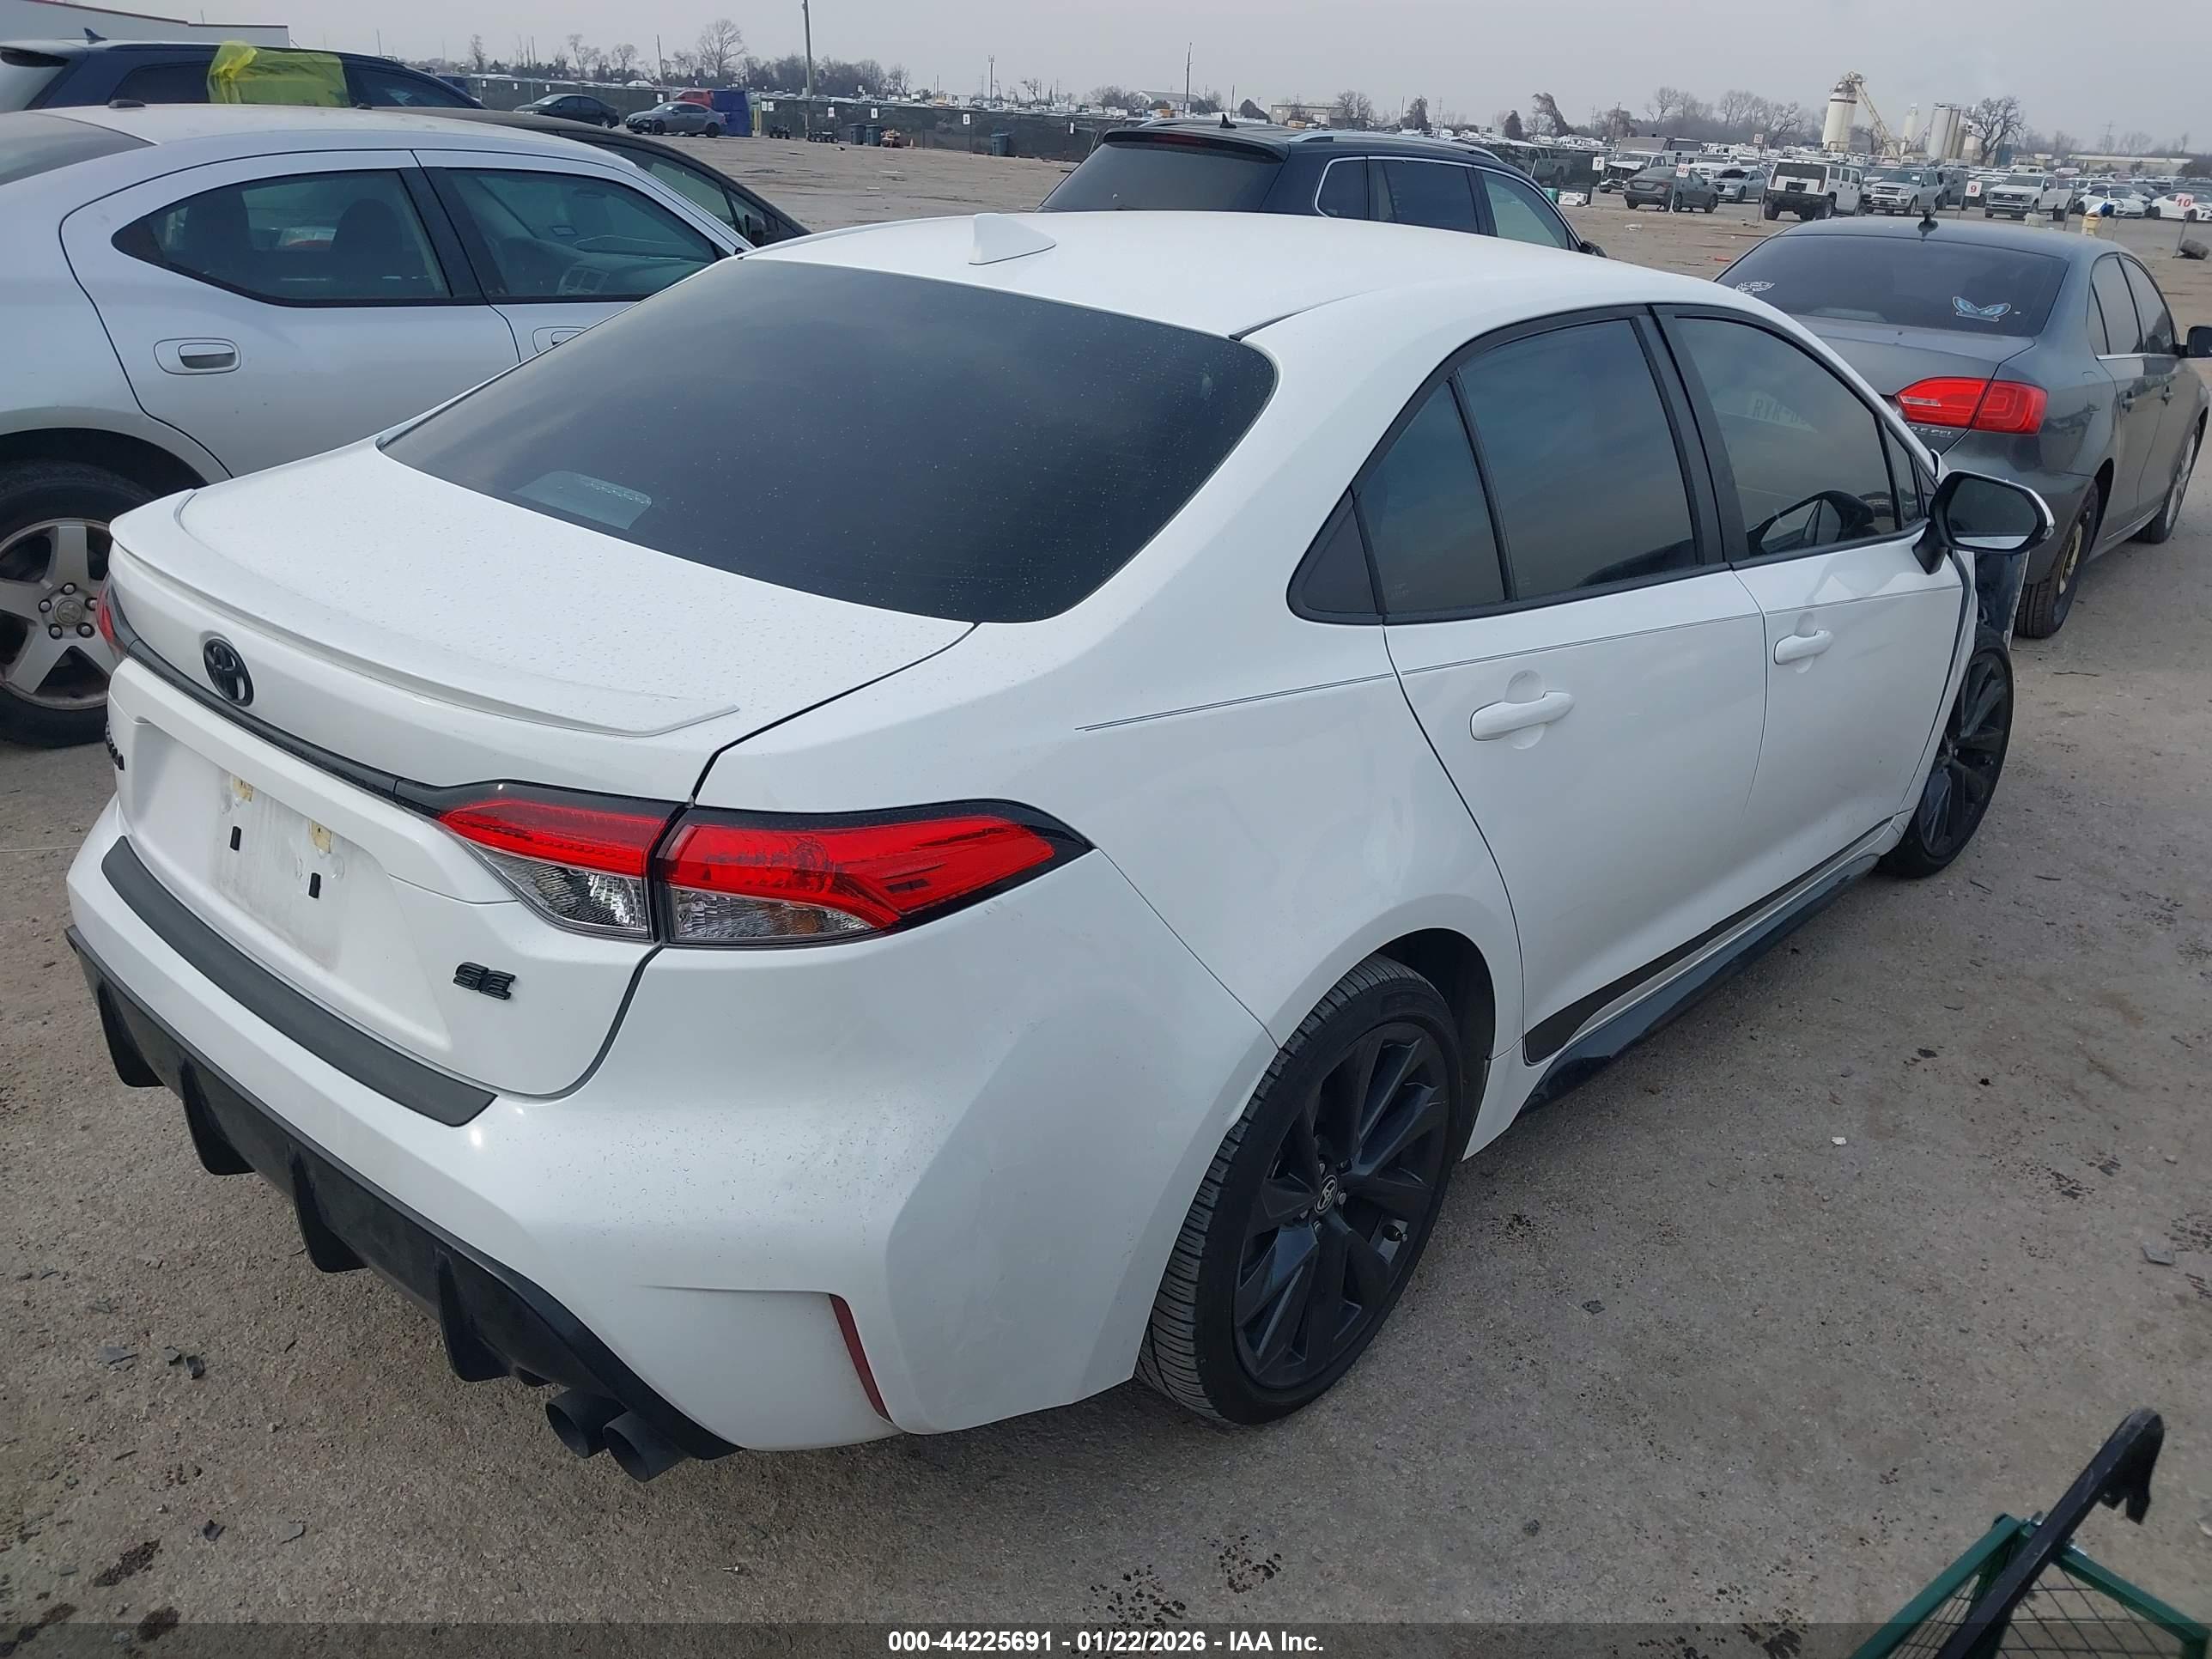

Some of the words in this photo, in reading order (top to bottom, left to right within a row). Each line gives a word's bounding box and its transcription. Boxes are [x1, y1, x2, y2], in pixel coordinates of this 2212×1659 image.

[1970, 185, 1977, 193] 9
[2177, 198, 2191, 208] 10
[453, 961, 517, 1000] SE
